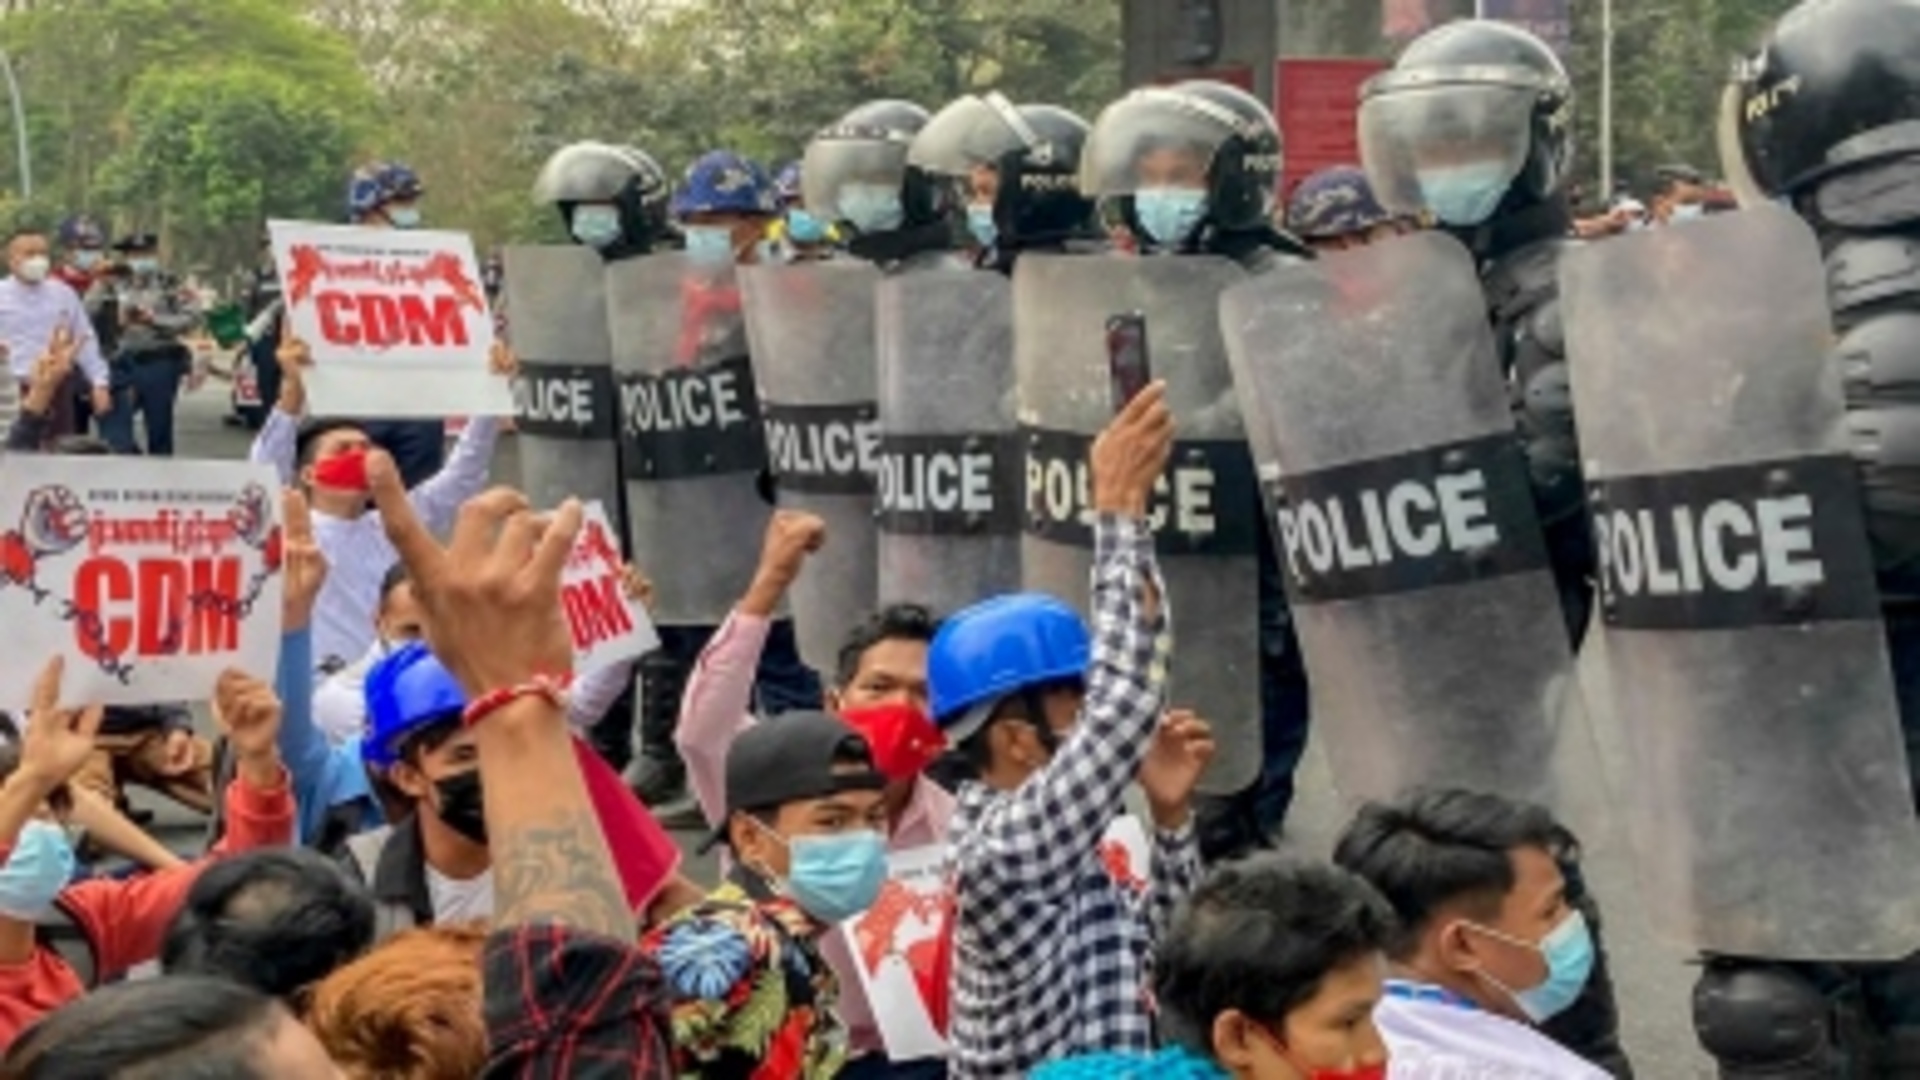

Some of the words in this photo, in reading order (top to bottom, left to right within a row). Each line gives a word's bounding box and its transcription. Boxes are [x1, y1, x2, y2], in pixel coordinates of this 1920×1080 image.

[316, 289, 470, 347] CDM
[878, 452, 993, 511] OLICE
[1278, 469, 1498, 575] POLICE
[74, 556, 241, 660] CDM
[562, 576, 633, 649] DM
